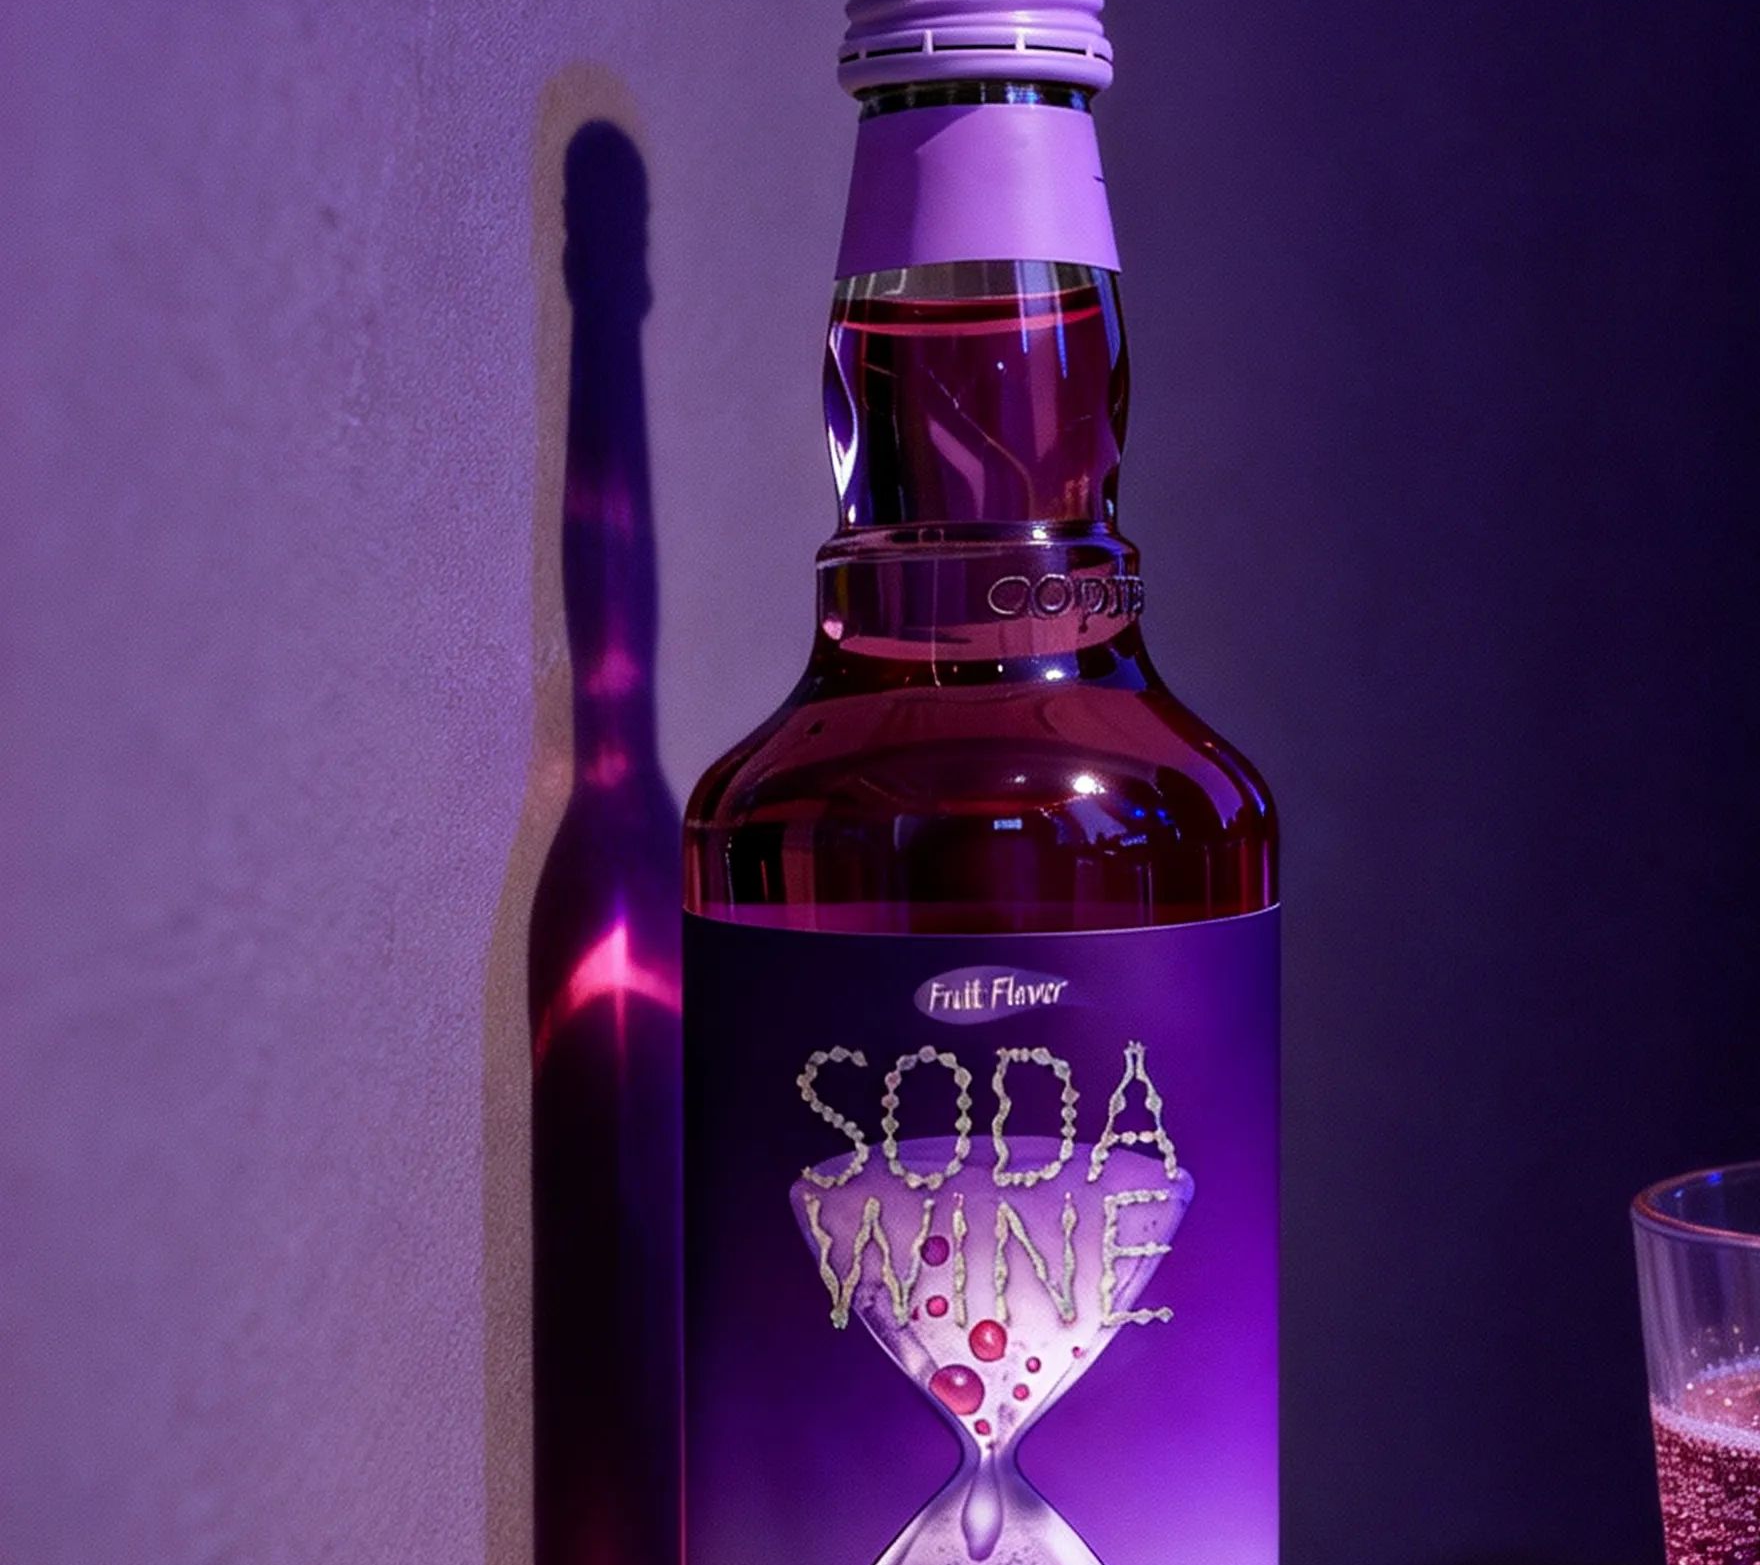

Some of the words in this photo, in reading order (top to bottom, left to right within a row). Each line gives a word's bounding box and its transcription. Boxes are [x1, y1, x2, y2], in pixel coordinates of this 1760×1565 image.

[929, 979, 983, 1013] Fruit
[797, 1039, 1180, 1189] SODA
[803, 1192, 1174, 1329] WINE
